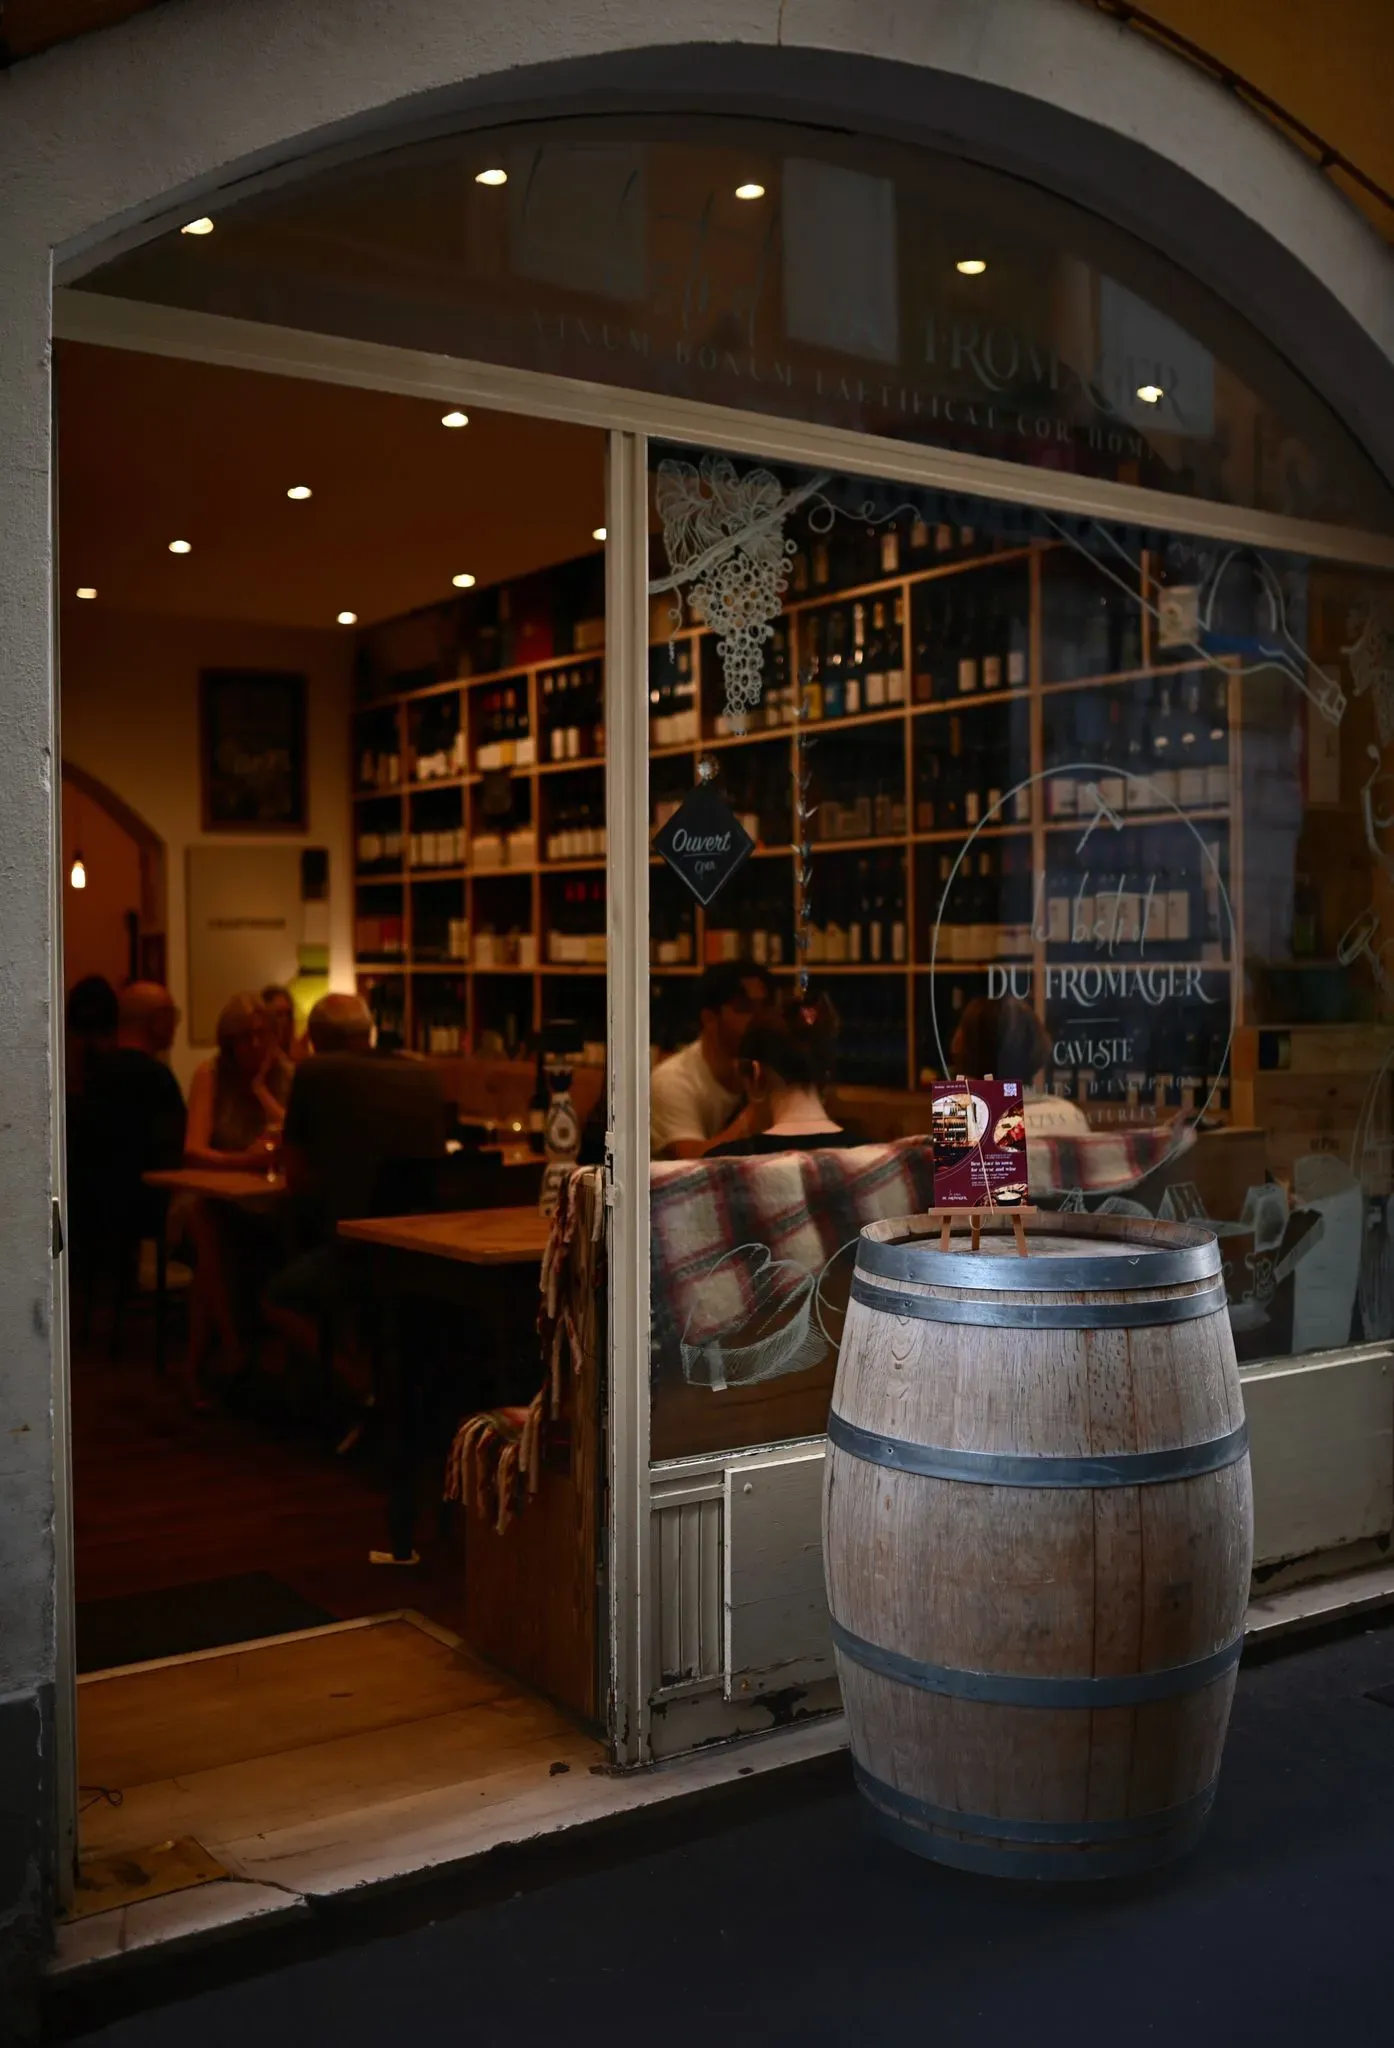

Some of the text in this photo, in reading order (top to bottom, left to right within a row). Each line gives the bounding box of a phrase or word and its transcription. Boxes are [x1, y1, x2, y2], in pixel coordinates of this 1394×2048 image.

[1017, 416, 1073, 445] COR
[672, 828, 732, 853] Ouvert
[986, 963, 1219, 1007] DU FROMAGER
[1053, 1037, 1134, 1070] CAVISTE
